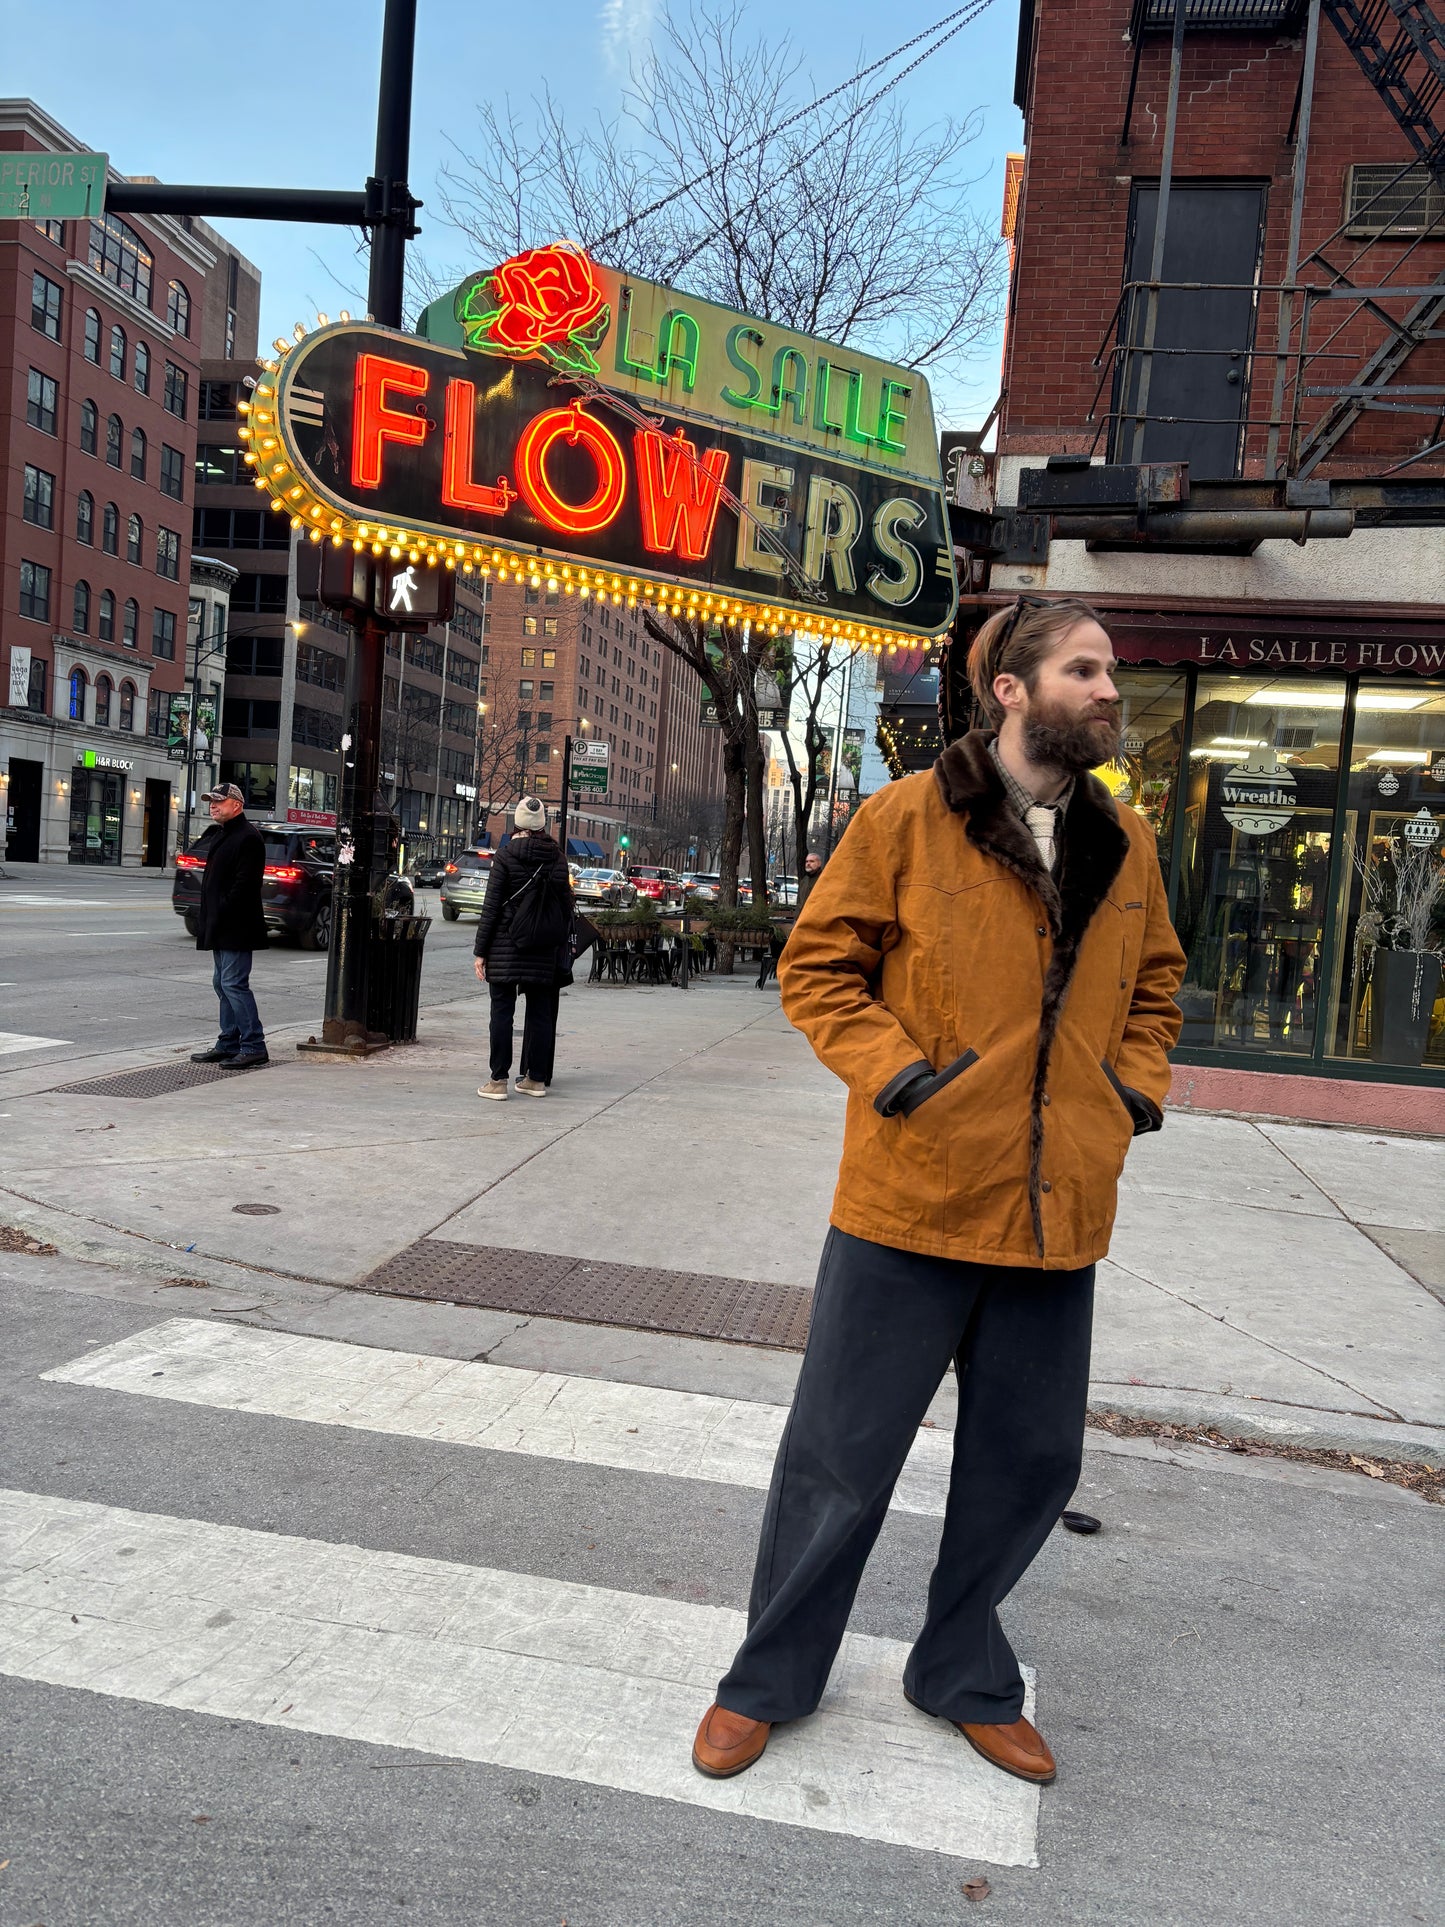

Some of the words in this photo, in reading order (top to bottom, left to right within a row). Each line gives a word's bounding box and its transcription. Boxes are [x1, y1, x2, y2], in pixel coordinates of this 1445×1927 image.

[80, 166, 98, 183] ST
[614, 283, 701, 395] LA
[719, 322, 914, 457] SALLE
[350, 352, 929, 608] FLOWERS
[1198, 636, 1240, 660] LA
[1248, 638, 1350, 664] SALLE
[95, 755, 111, 767] H&R
[111, 759, 134, 771] BLOCK
[1222, 786, 1297, 806] Wreaths
